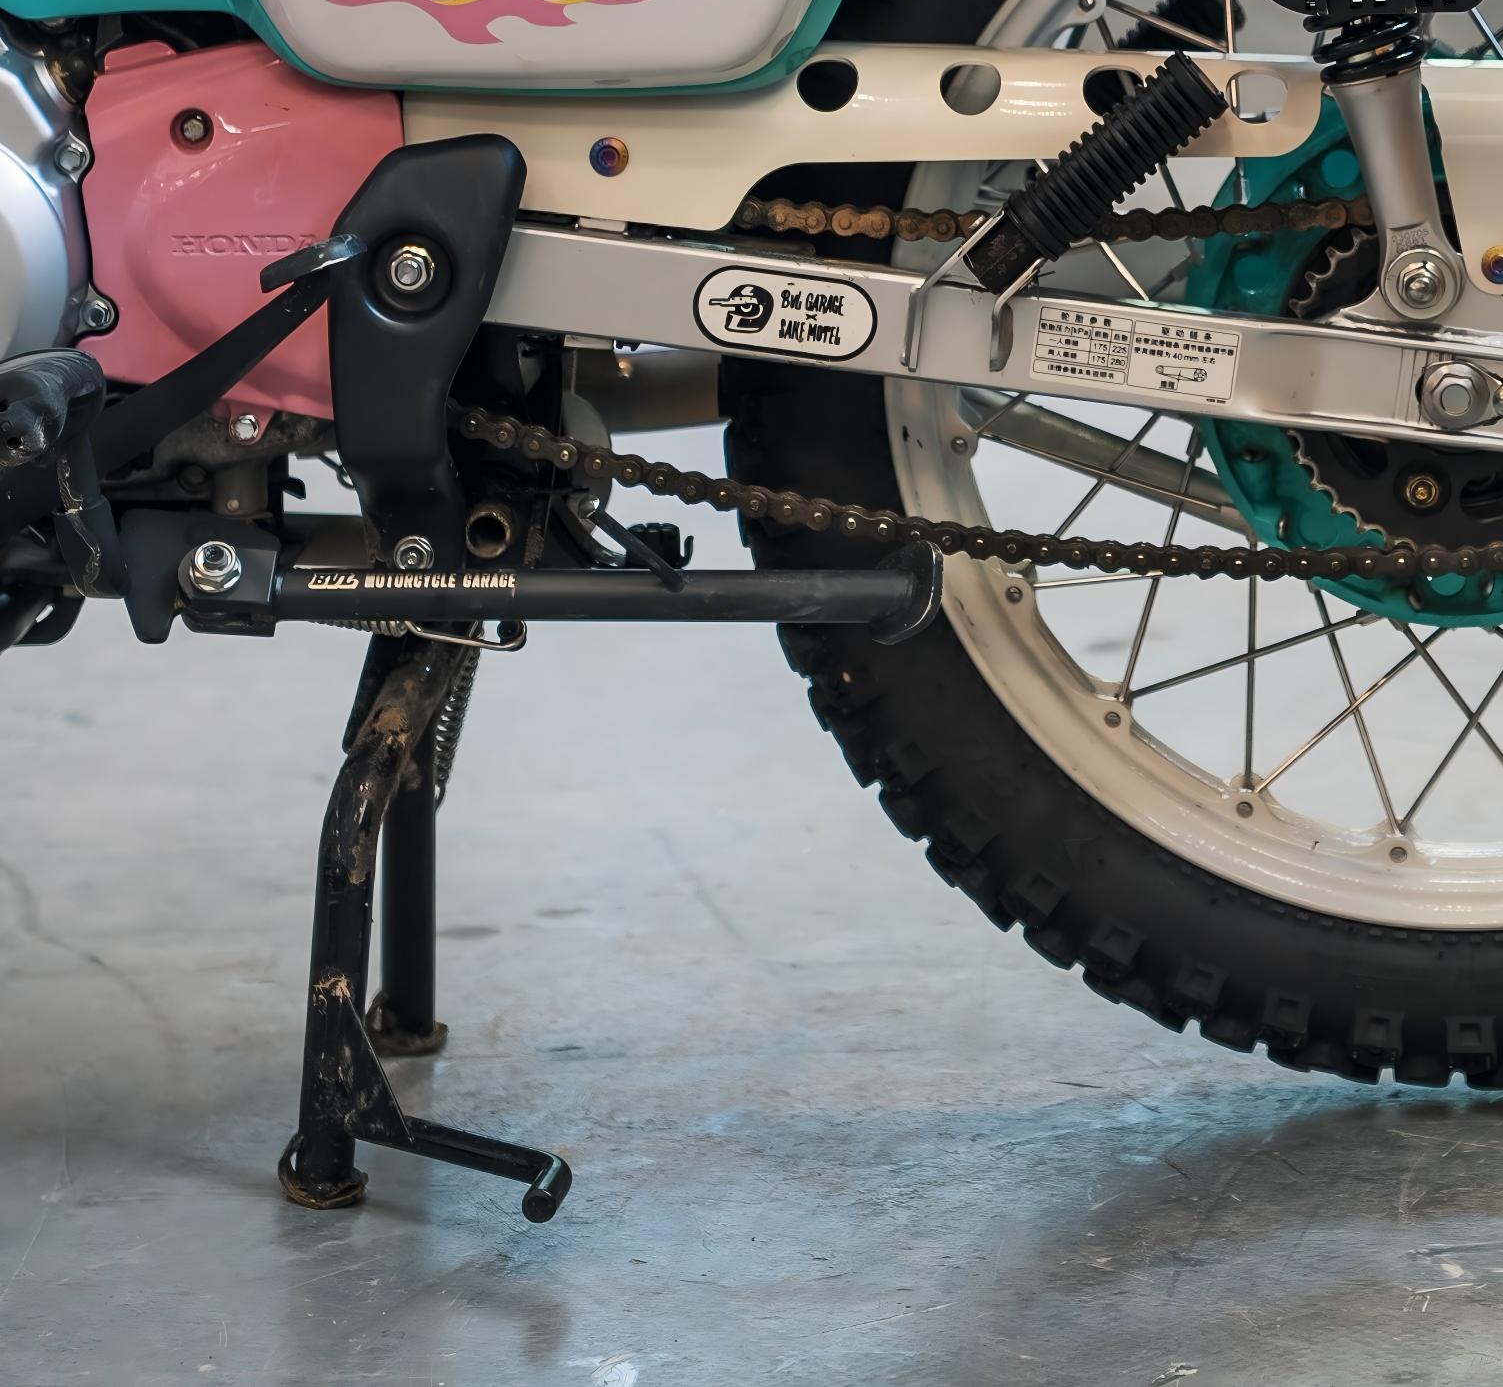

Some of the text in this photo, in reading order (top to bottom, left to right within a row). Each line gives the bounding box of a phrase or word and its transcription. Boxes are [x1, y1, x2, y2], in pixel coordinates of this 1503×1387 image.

[805, 293, 845, 316] GARAGE
[779, 319, 841, 345] SAKE MOTEL
[1093, 342, 1108, 352] 175
[1111, 345, 1128, 355] 225
[1091, 354, 1106, 364] 175
[1172, 352, 1184, 362] 40
[364, 573, 456, 589] MOTORCYCLE
[462, 573, 516, 589] GARAGE
